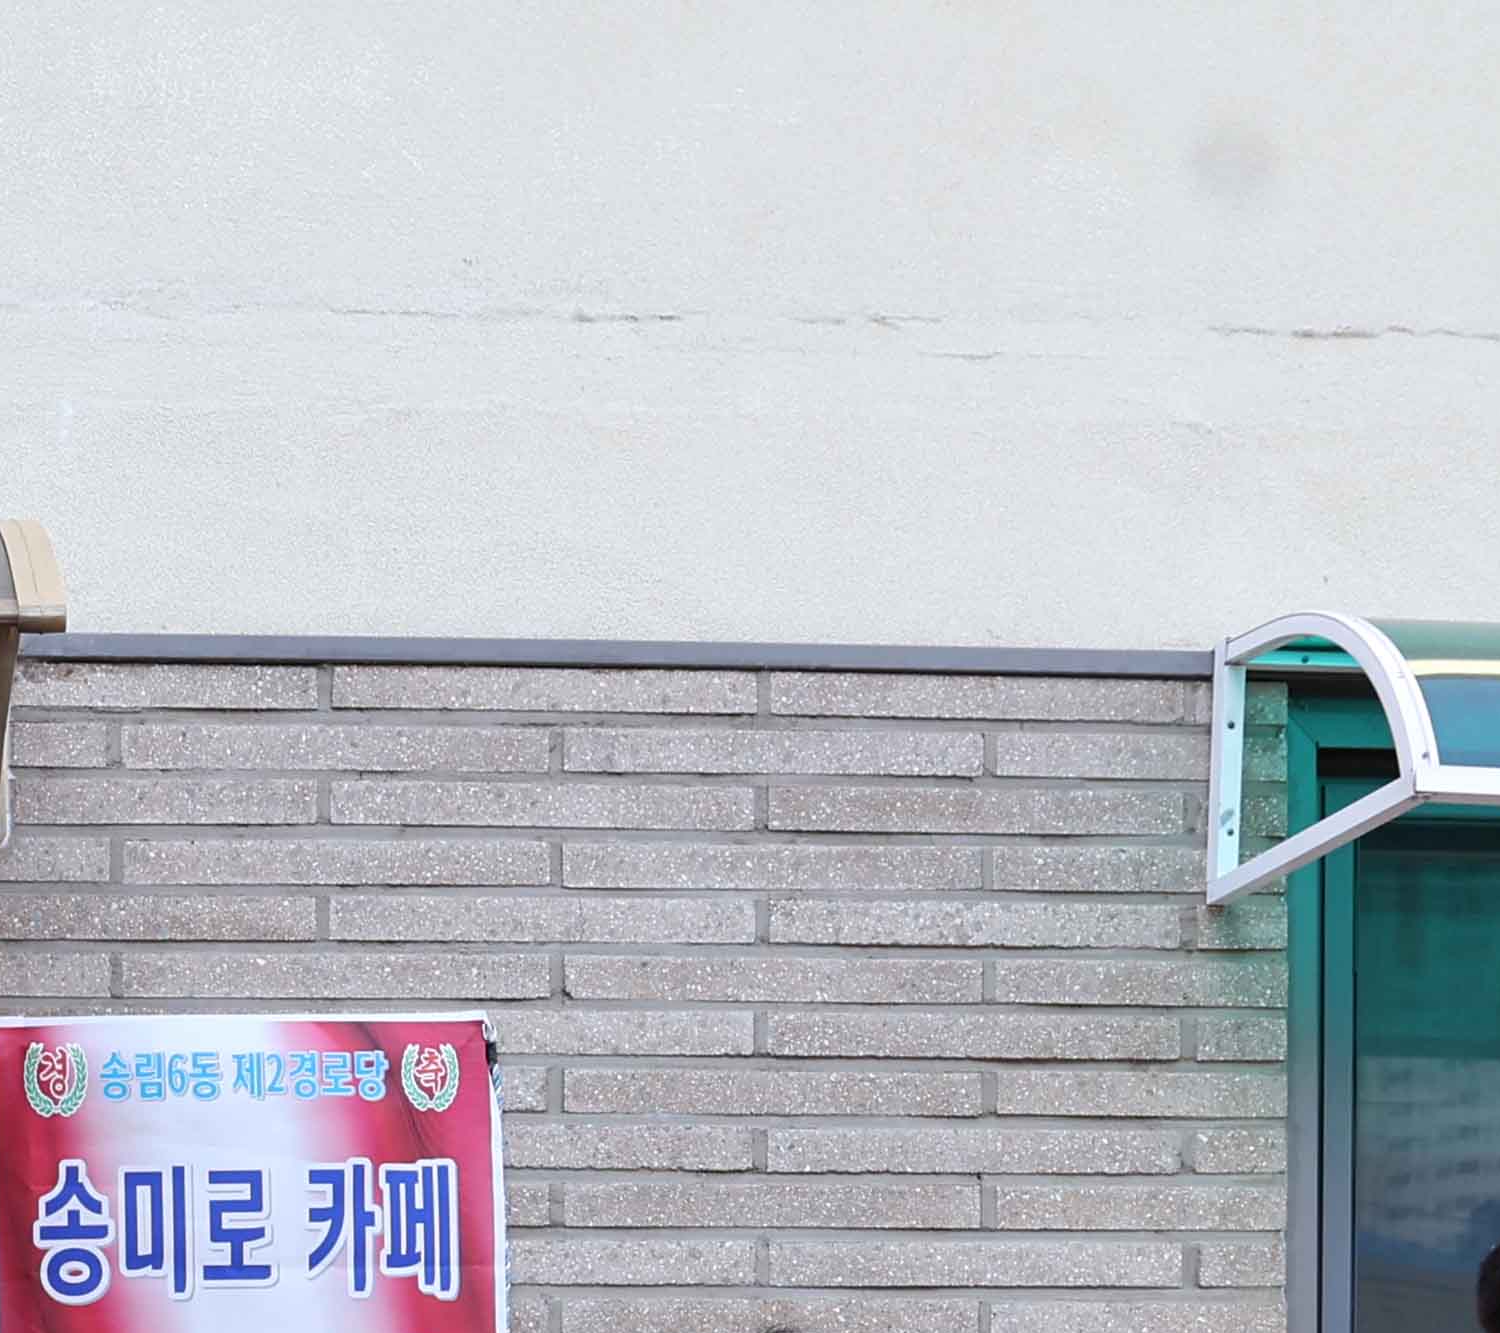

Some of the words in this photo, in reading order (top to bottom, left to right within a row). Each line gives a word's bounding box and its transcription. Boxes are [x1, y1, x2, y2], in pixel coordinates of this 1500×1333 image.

[37, 1046, 70, 1099] 경
[99, 1049, 221, 1100] 송림6동
[232, 1050, 388, 1101] 제2경로당
[414, 1049, 445, 1094] 축
[36, 1161, 276, 1300] 송미로
[305, 1160, 458, 1298] 카페
